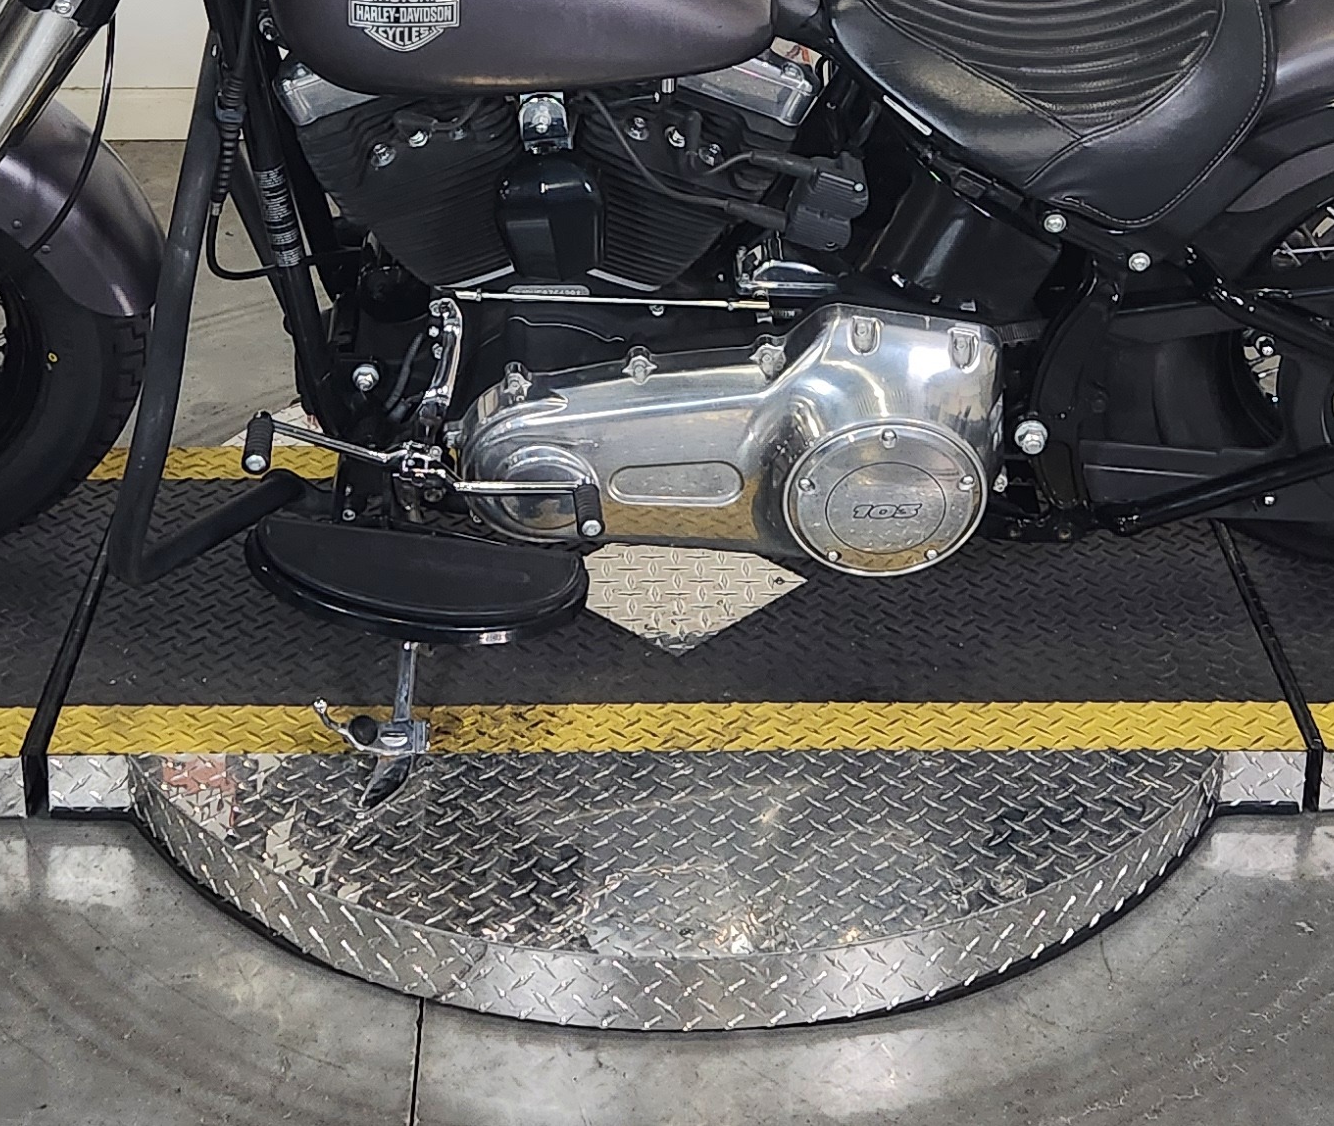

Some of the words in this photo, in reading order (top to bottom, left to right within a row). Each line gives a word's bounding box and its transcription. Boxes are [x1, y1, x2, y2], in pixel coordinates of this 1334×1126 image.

[356, 5, 452, 23] HARLEY-DAVIDSON
[378, 27, 429, 45] CYCLES
[853, 503, 922, 519] 103
